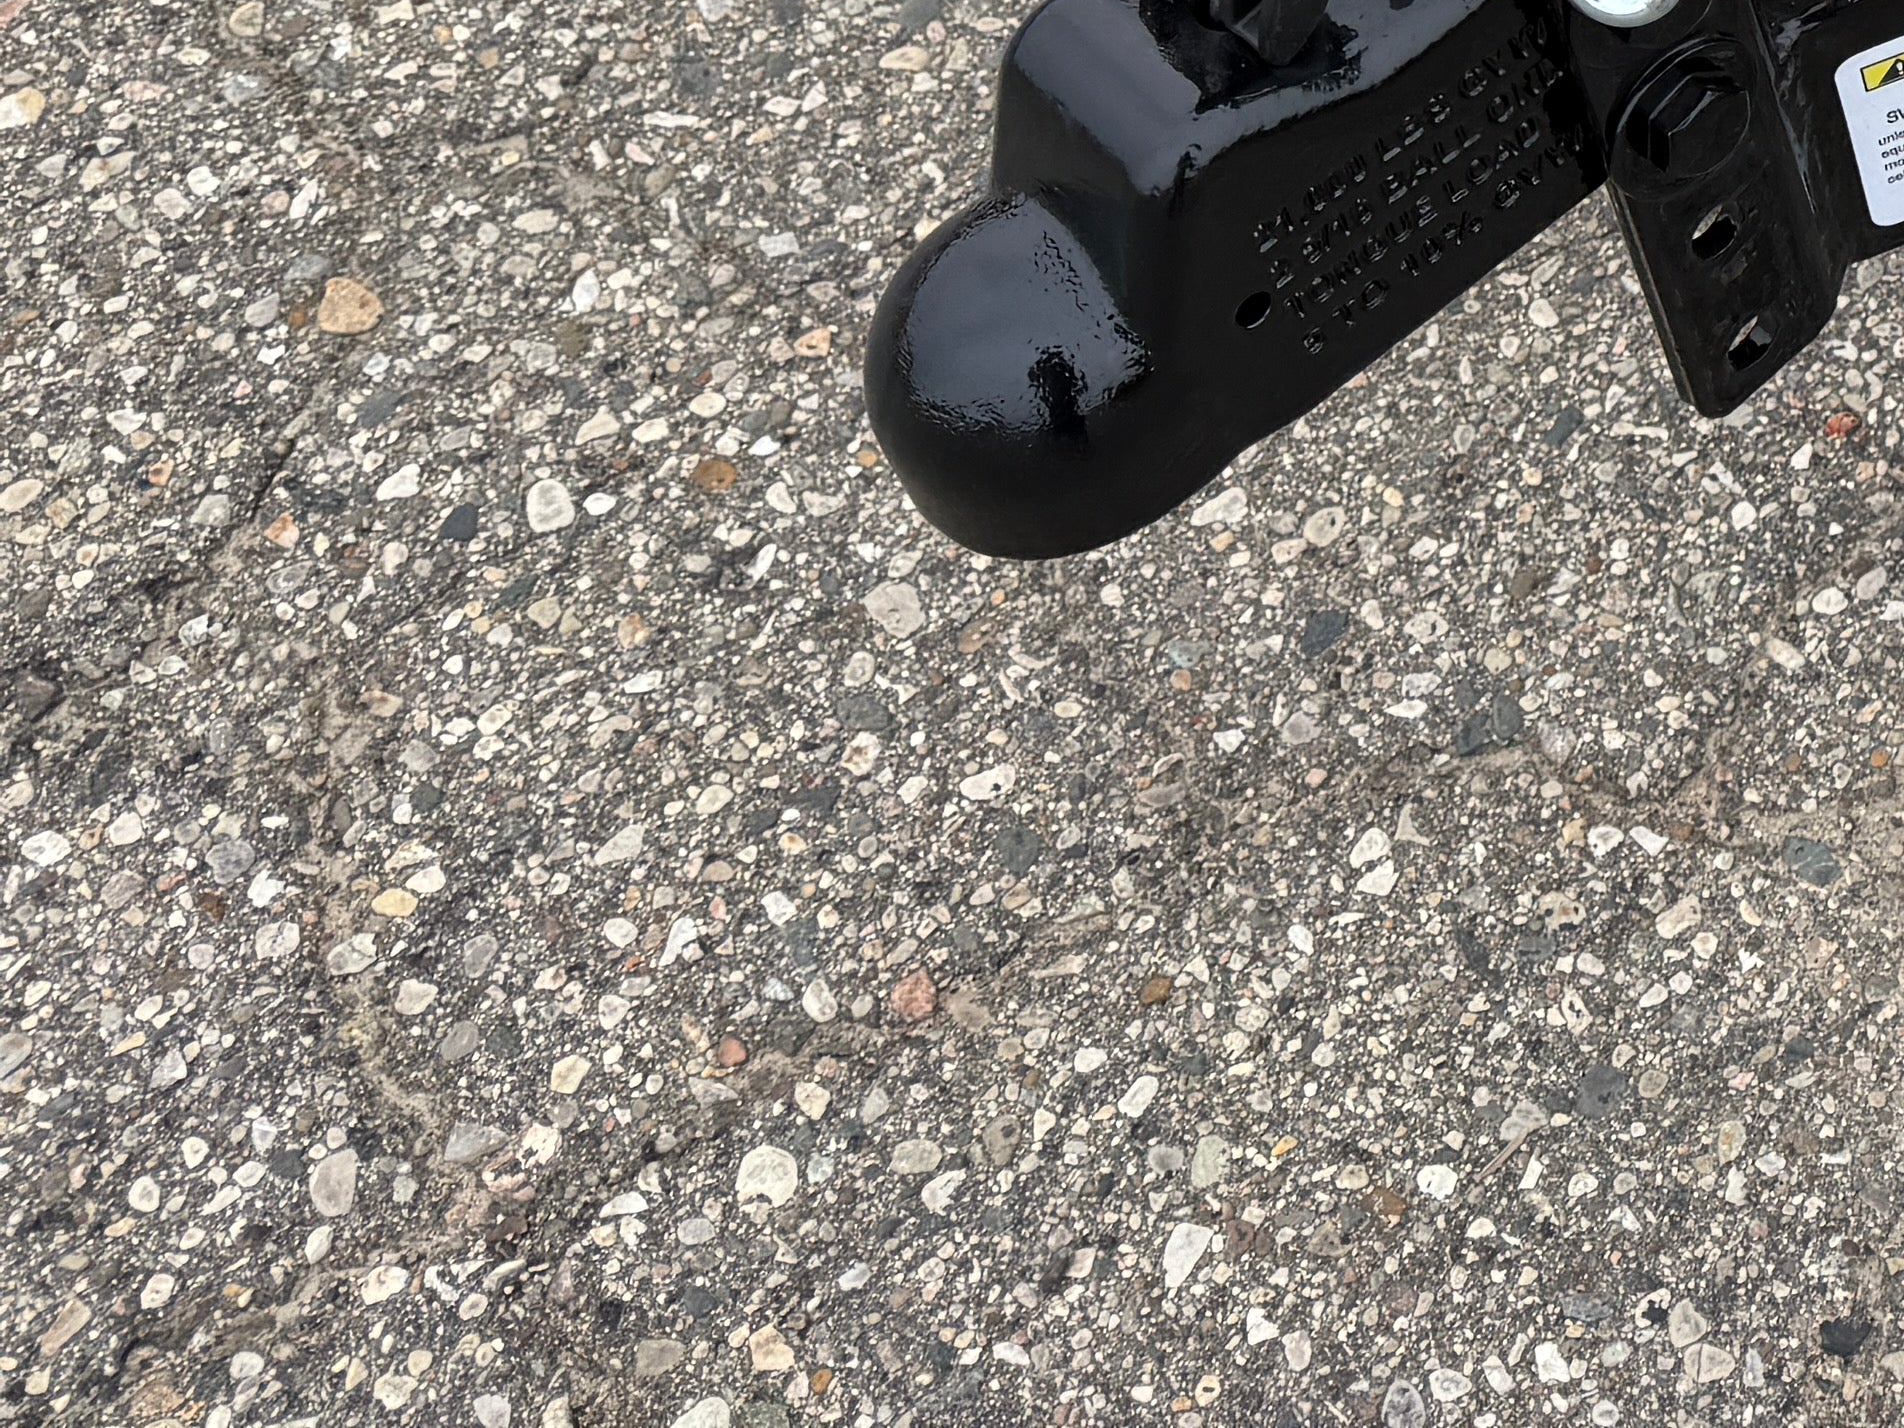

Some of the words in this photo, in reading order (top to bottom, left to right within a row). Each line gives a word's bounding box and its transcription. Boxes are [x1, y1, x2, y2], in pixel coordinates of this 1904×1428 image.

[1379, 113, 1483, 206] BALL
[1280, 190, 1440, 325] TONGUE
[1440, 113, 1544, 207] LOAD
[1328, 270, 1393, 336] TO
